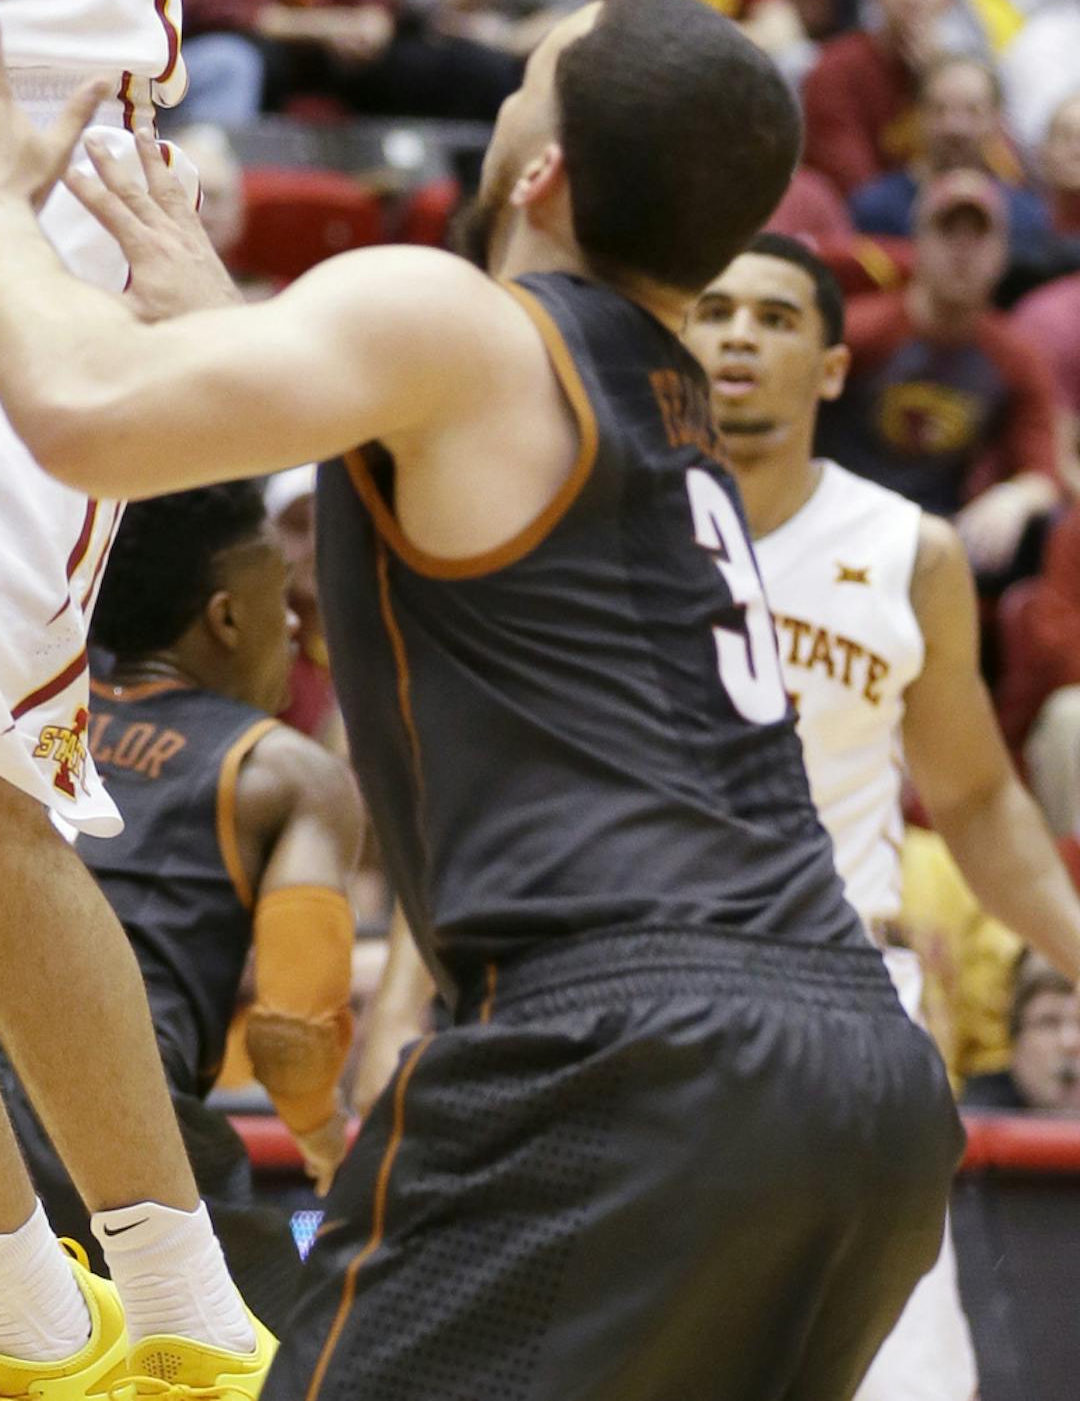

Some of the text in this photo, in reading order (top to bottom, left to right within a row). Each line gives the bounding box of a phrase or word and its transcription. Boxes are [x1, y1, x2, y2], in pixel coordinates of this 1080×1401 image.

[685, 466, 788, 725] 3
[770, 611, 890, 707] TATE
[88, 713, 186, 780] LOR
